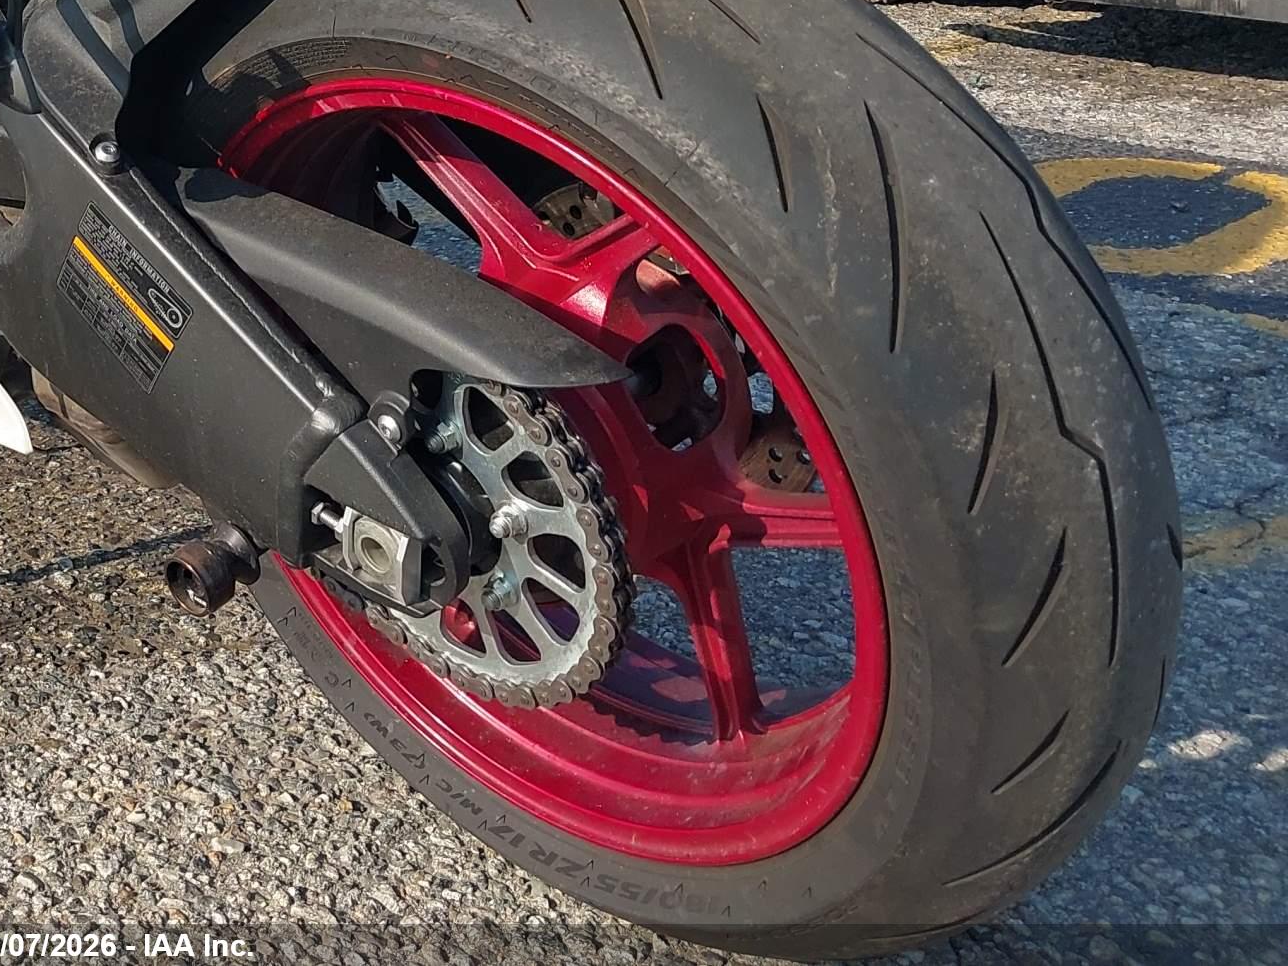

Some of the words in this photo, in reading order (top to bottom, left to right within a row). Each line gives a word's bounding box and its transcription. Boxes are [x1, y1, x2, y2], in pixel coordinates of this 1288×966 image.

[108, 225, 127, 247] CHAIN
[129, 246, 170, 293] INFORMATION
[110, 279, 139, 312] WARNING
